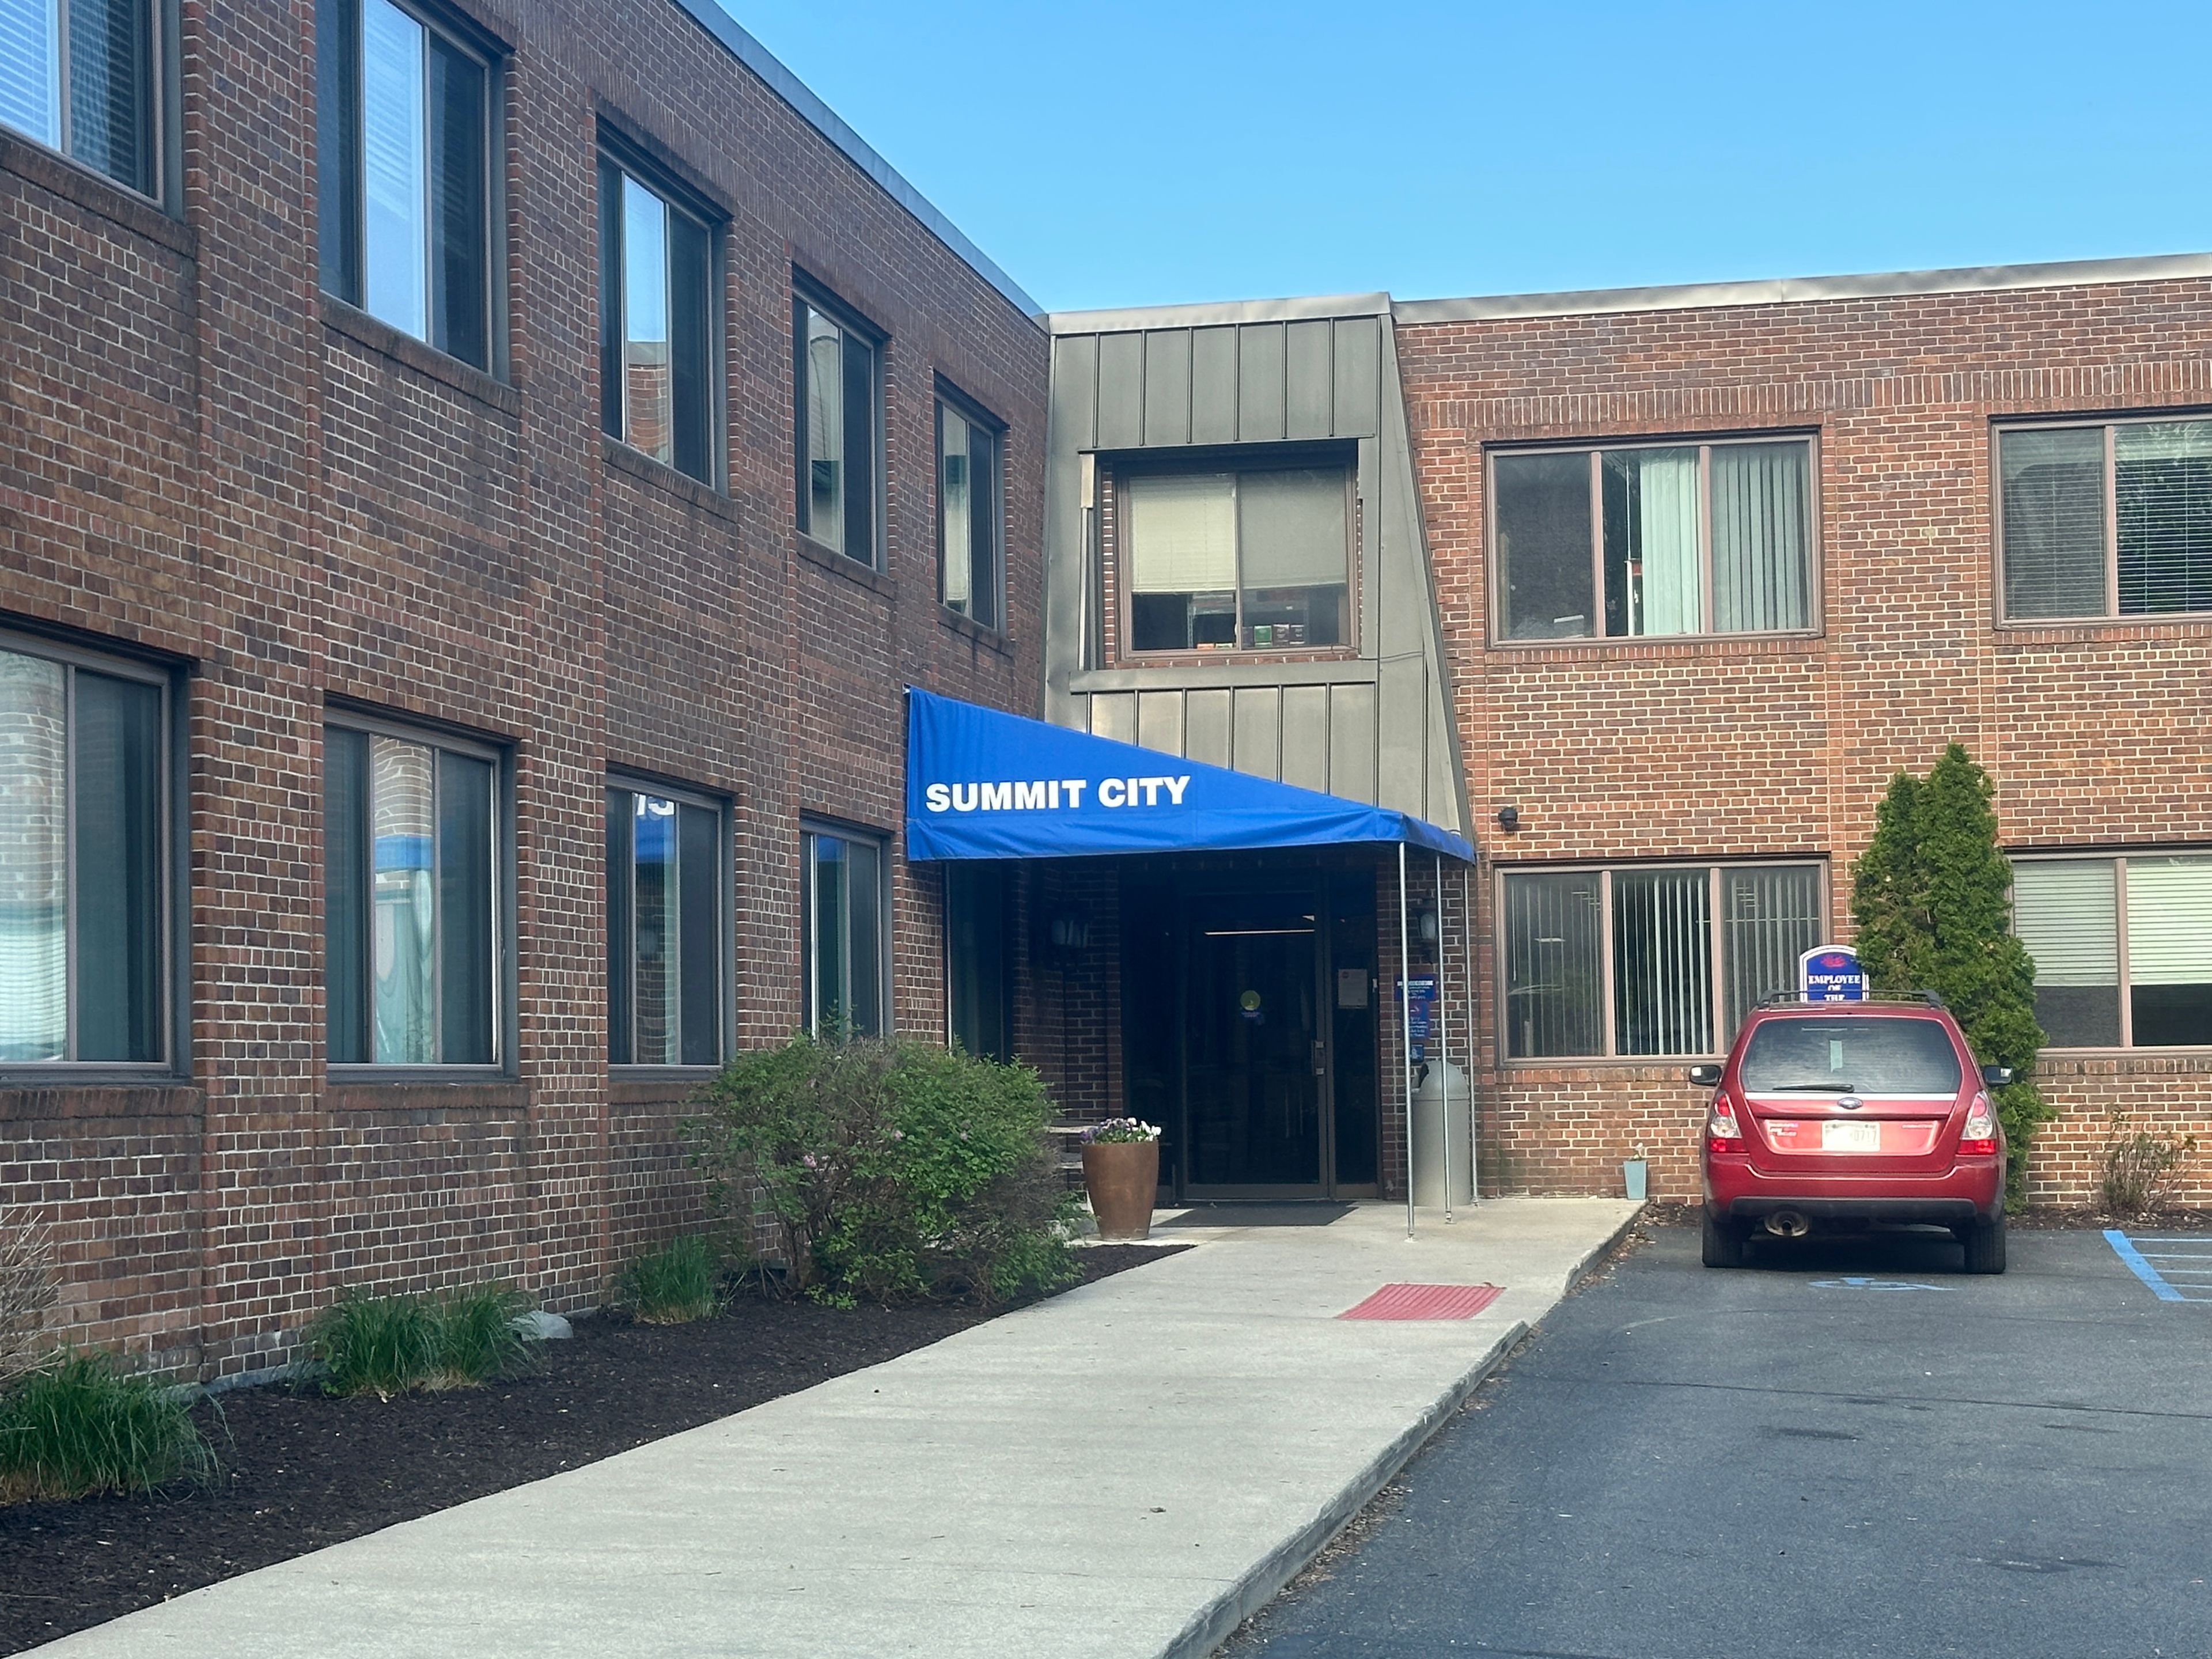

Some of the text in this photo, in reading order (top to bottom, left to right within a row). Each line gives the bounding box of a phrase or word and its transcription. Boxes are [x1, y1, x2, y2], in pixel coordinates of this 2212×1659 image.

[926, 775, 1191, 812] SUMMIT CITY
[1808, 975, 1861, 984] EMPLOYEE
